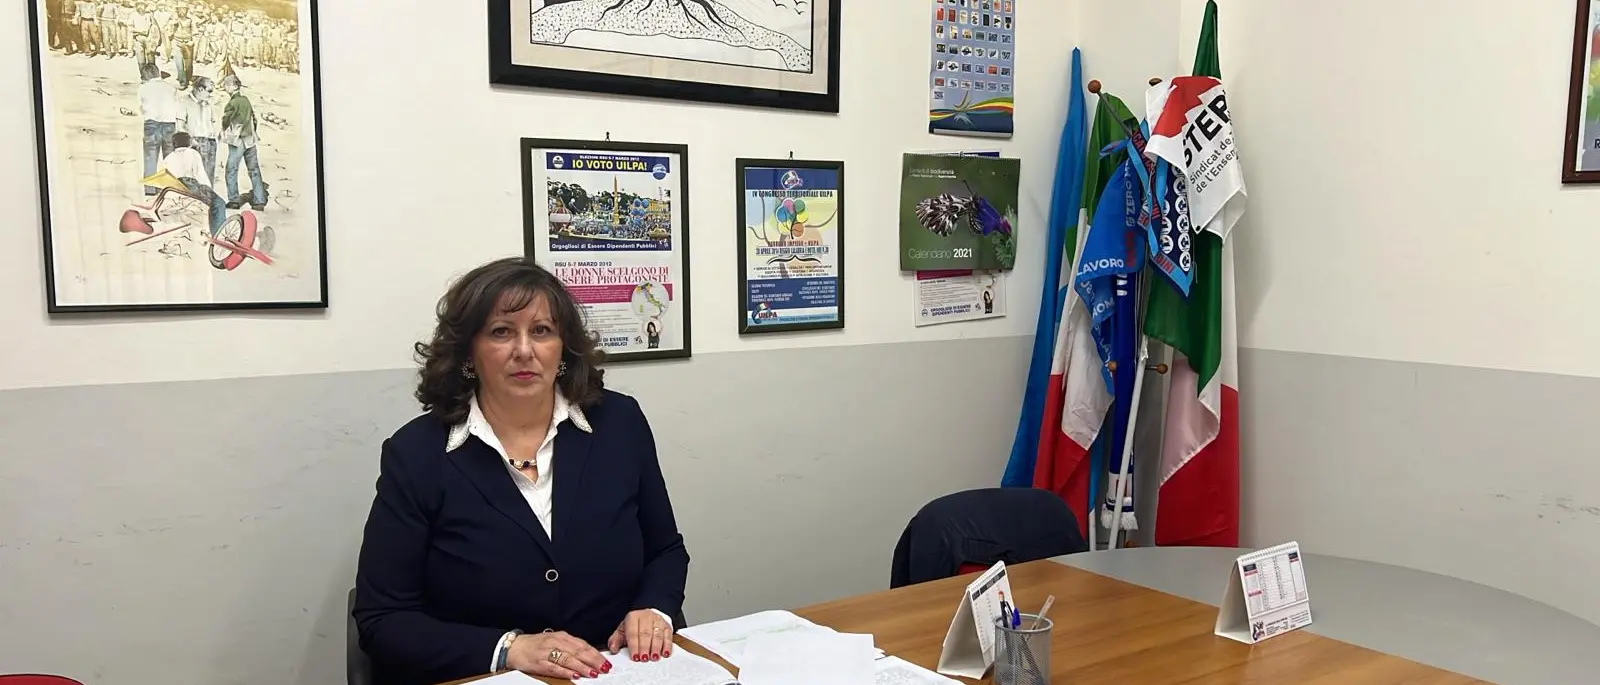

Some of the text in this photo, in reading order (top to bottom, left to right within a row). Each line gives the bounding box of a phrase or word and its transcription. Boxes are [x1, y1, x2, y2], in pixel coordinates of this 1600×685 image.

[1183, 91, 1232, 168] STEP
[572, 159, 584, 169] IO
[586, 160, 614, 170] VOTO
[616, 161, 647, 171] UILPA!
[1190, 138, 1232, 184] Sindicat de
[1196, 149, 1236, 193] de l'Ensen
[908, 248, 972, 259] Calendario 2021
[555, 266, 669, 276] LE DONNE SCELGONO DI
[558, 274, 670, 284] SSERE PROTAGONISTE
